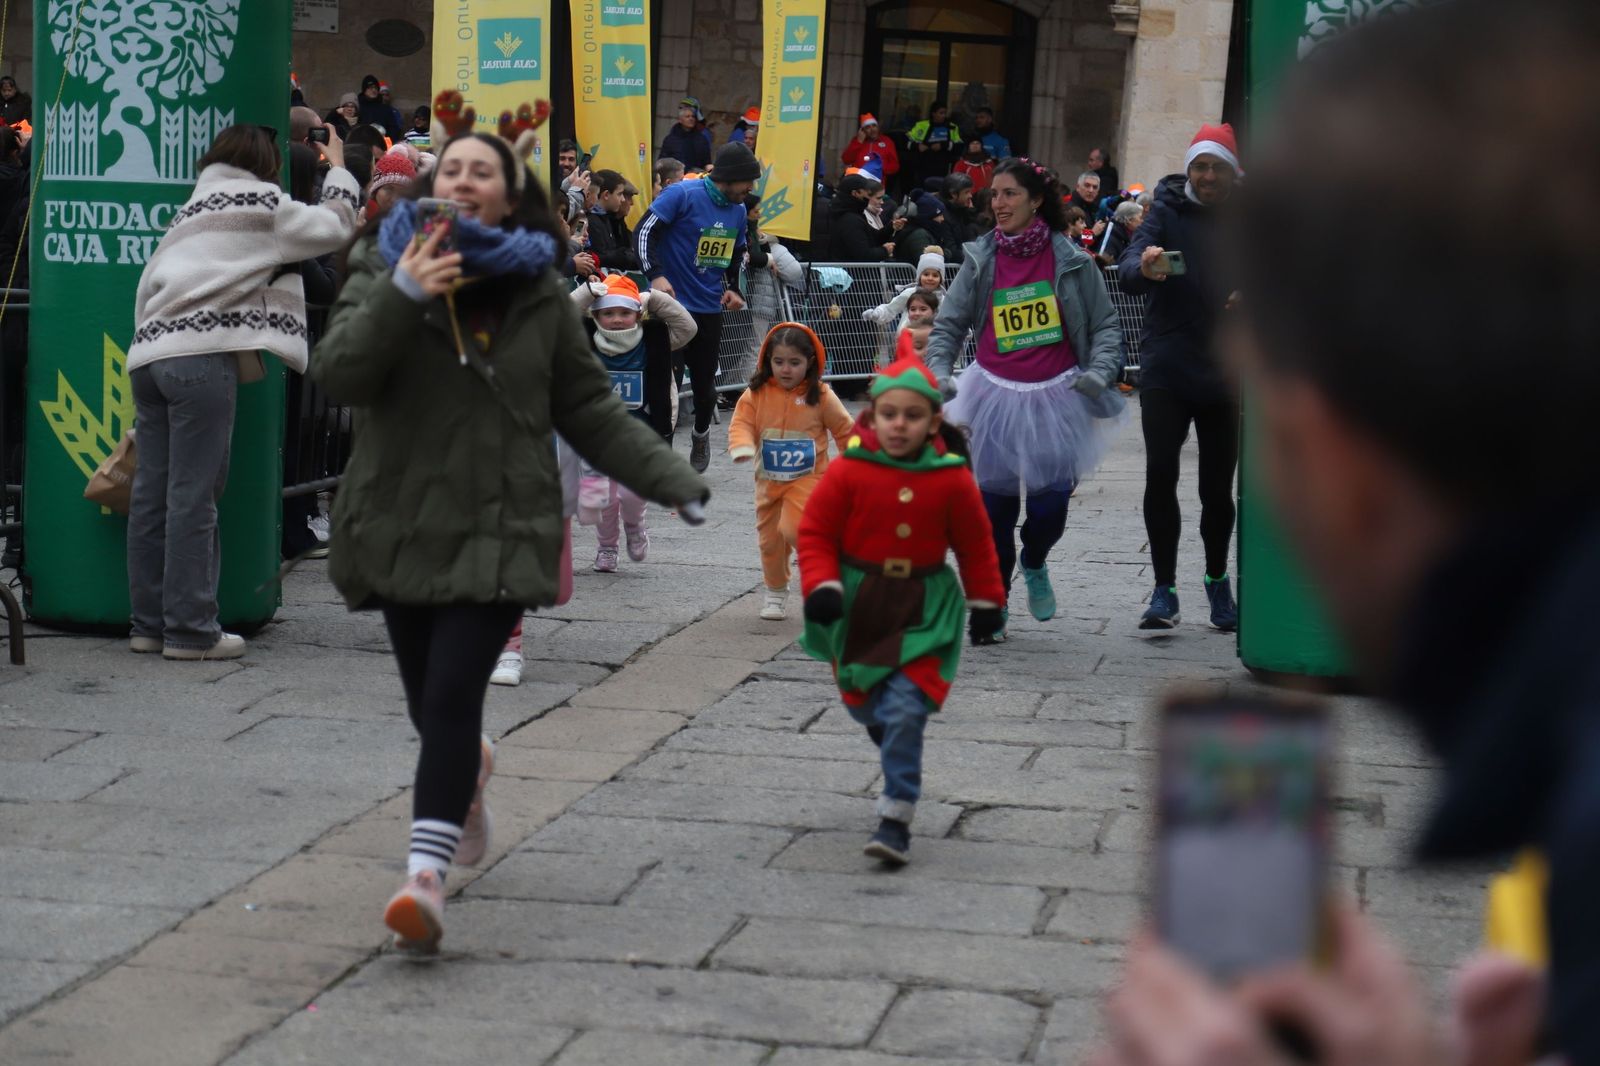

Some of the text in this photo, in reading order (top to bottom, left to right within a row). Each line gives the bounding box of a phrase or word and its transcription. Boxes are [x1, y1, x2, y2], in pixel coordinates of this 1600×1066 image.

[43, 232, 109, 265] CAJA
[699, 240, 728, 257] 961
[998, 301, 1050, 333] 1678
[1016, 336, 1034, 345] CAJA
[611, 381, 632, 398] 41
[769, 450, 805, 467] 122
